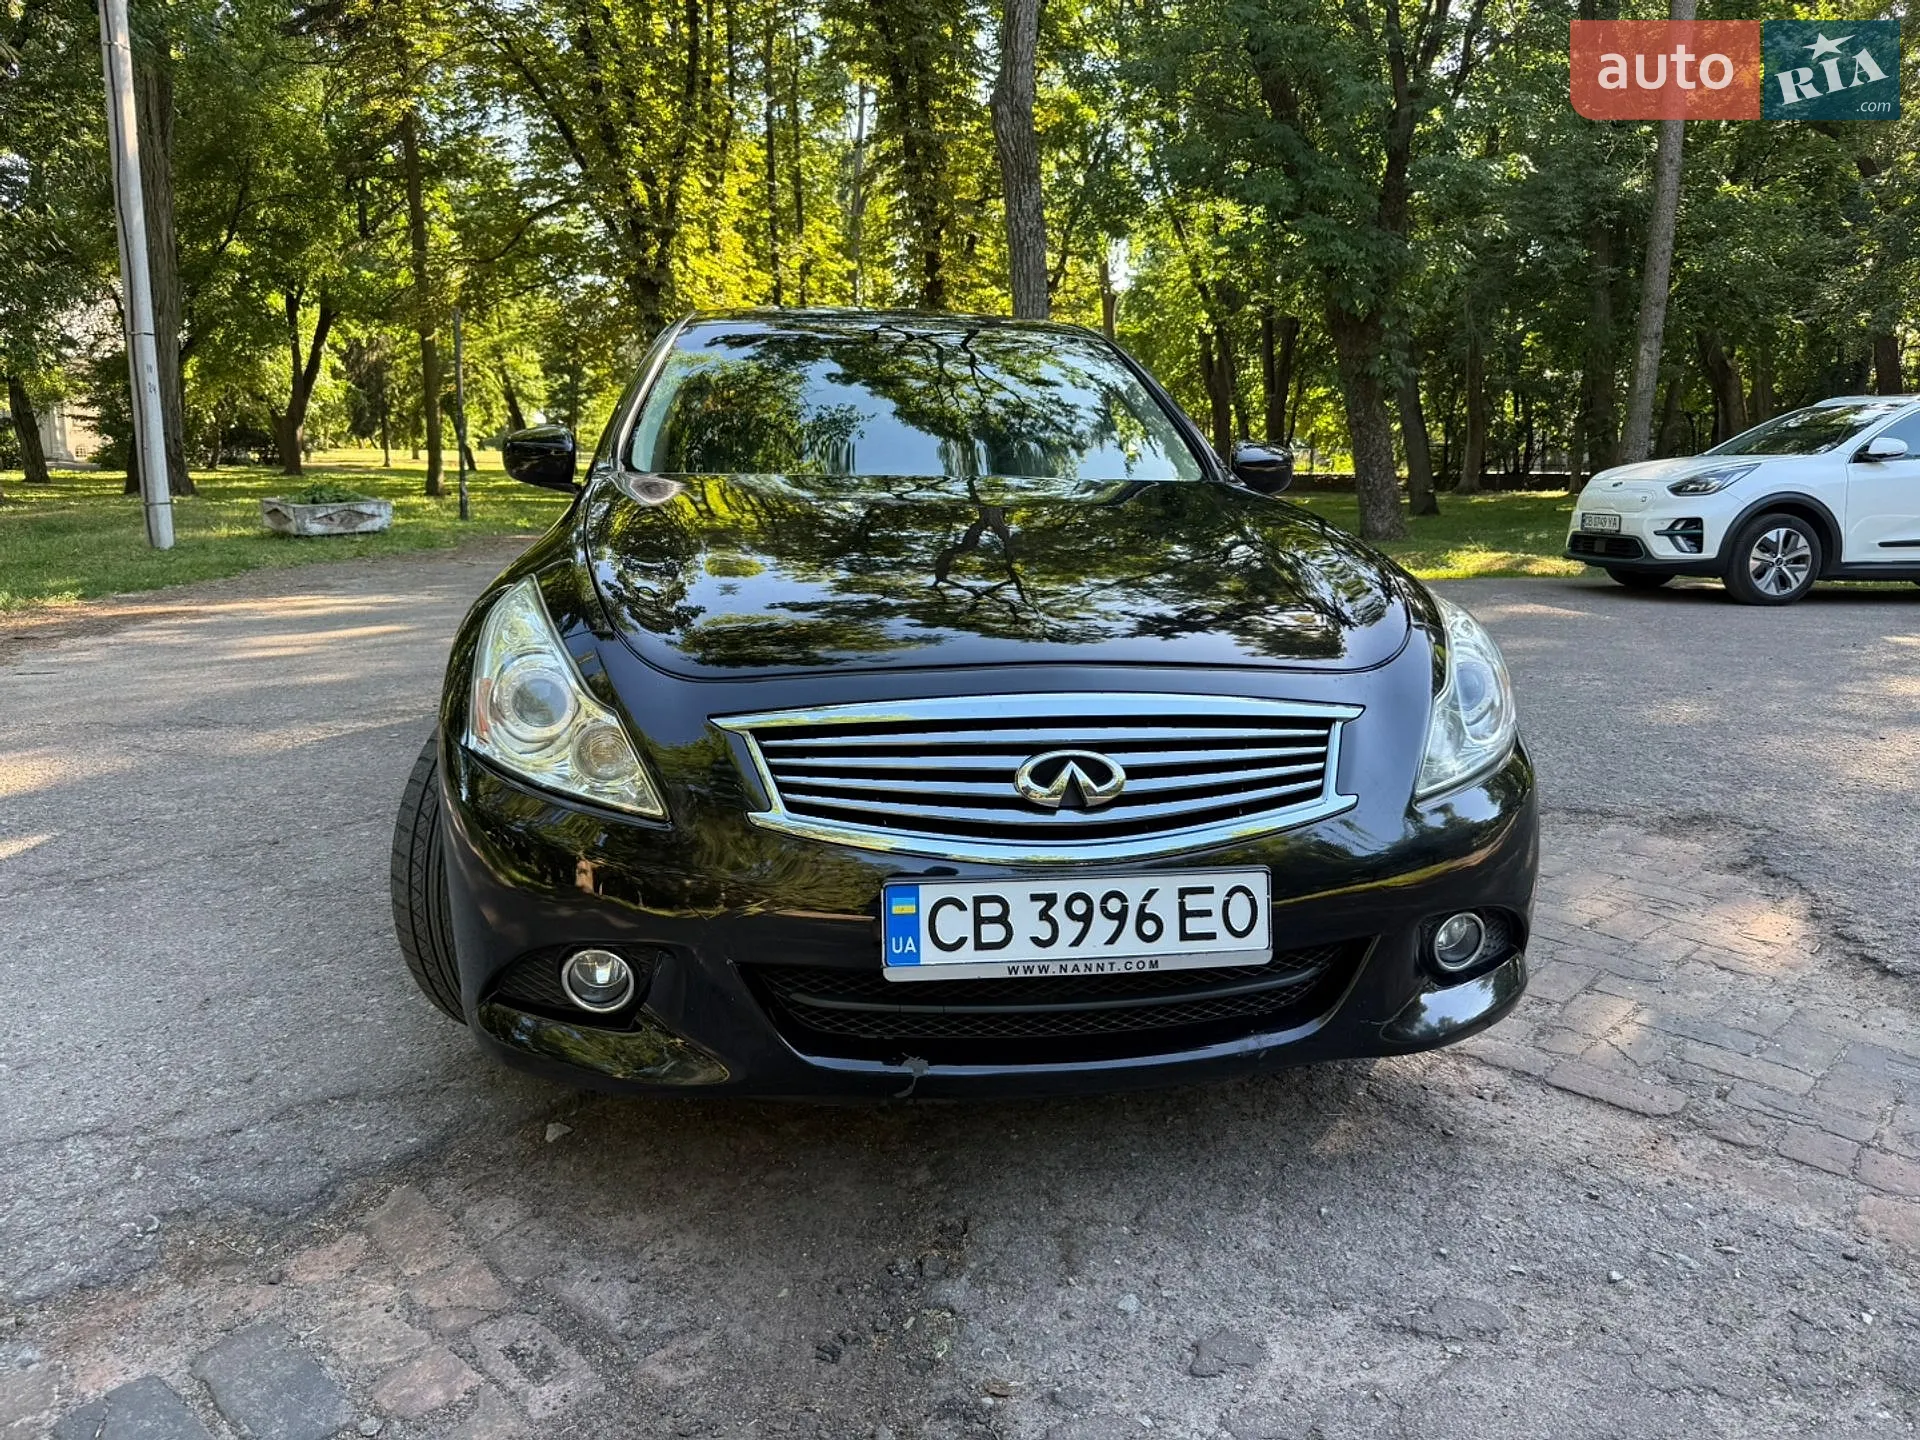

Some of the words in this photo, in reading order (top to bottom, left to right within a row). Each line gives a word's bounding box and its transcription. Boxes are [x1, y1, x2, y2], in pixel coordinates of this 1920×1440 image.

[927, 894, 1014, 952] CB
[1028, 888, 1165, 949] 3996
[1177, 884, 1259, 942] EO
[891, 936, 917, 954] UA
[1007, 959, 1160, 976] WWW.NANNT.COM
